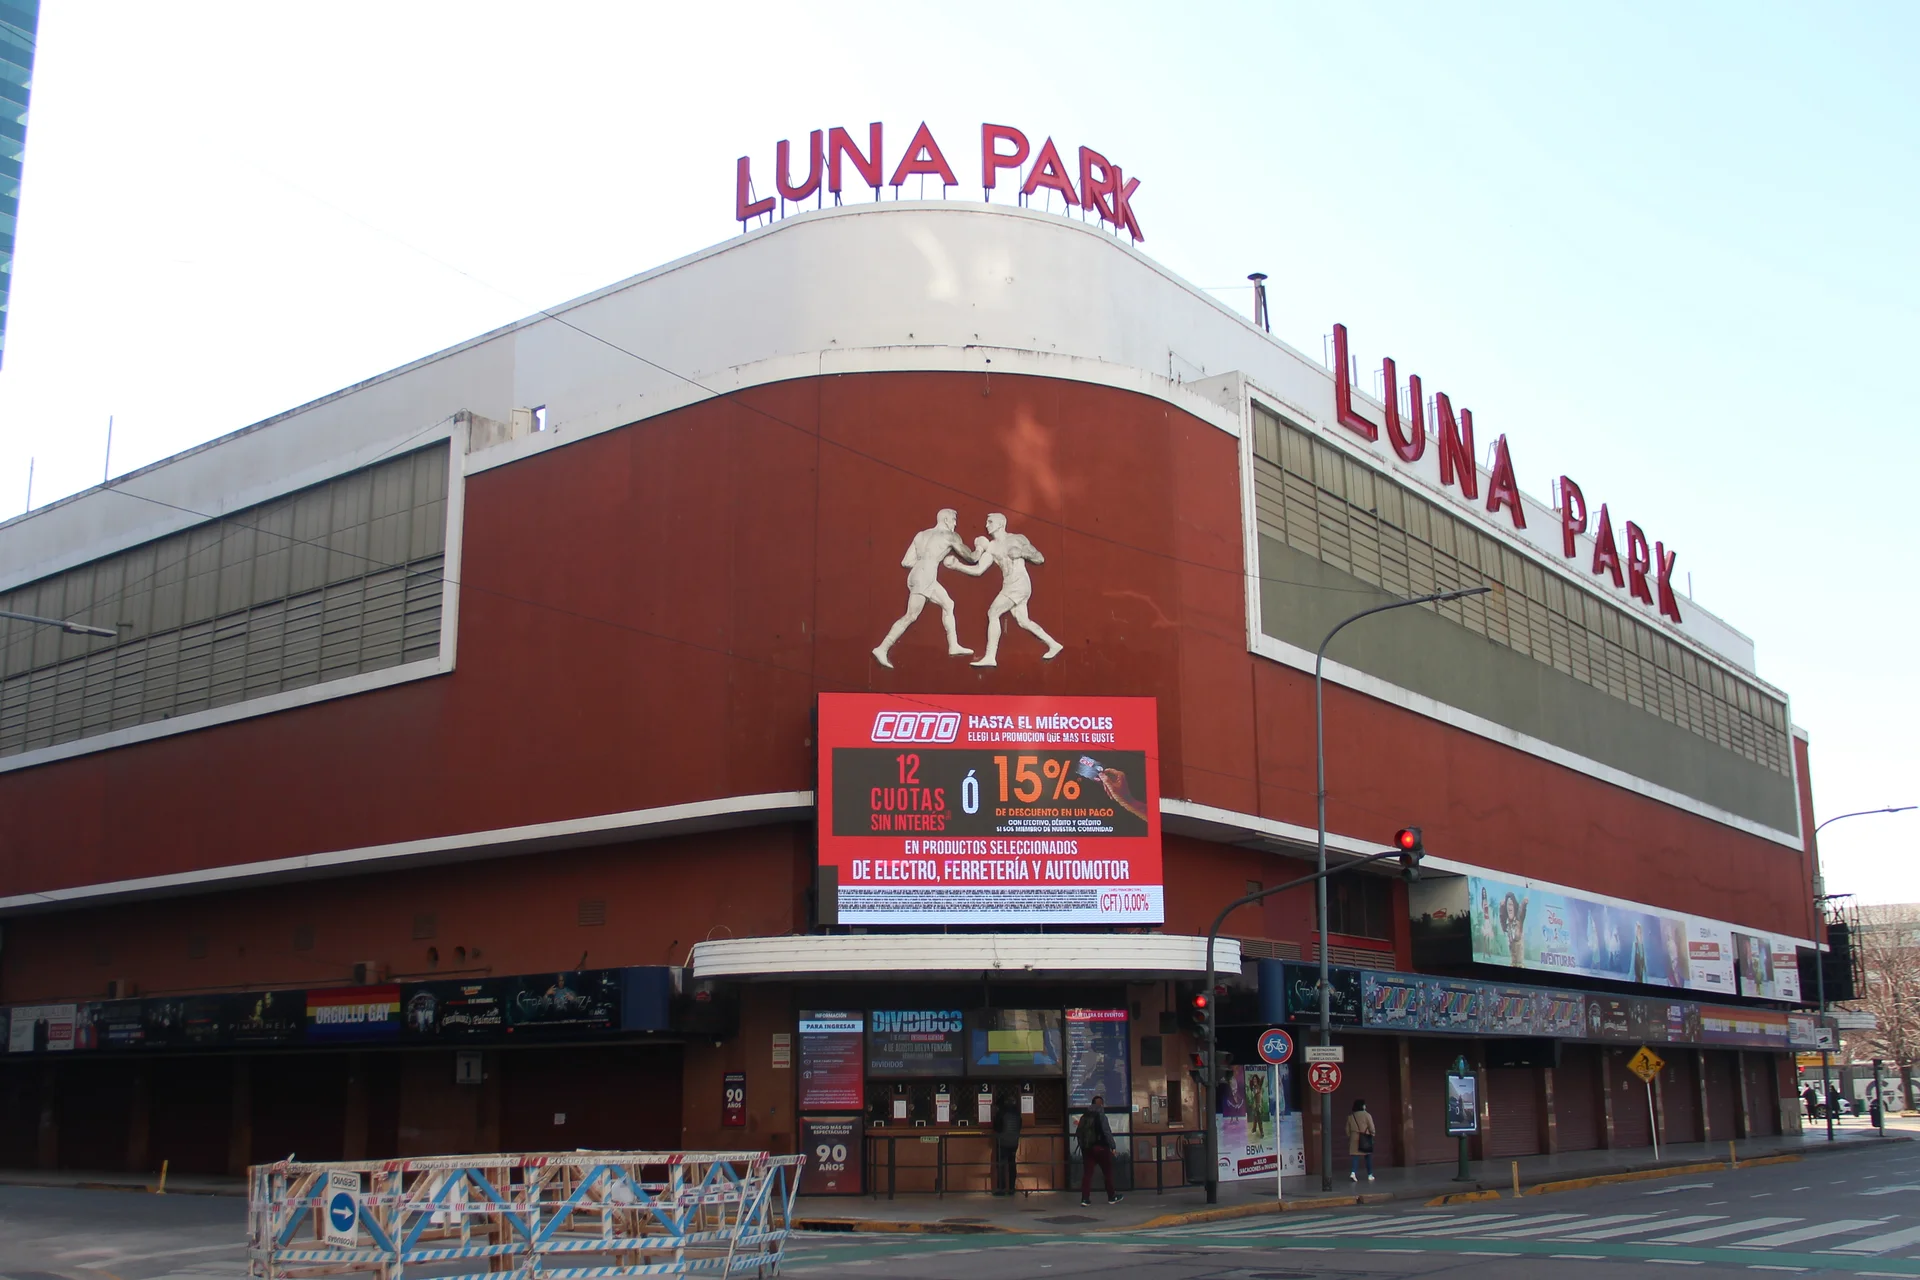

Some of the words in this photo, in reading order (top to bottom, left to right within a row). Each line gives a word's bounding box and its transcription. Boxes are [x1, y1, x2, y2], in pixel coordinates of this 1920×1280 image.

[736, 121, 958, 221] LUNA
[982, 122, 1144, 242] PARK
[1333, 323, 1527, 529] LUNA
[1560, 475, 1682, 623] PARK
[873, 713, 961, 741] COTO
[968, 715, 1014, 729] HASTA
[1018, 716, 1032, 729] EL
[1035, 712, 1113, 730] MIÉRCOLES
[968, 732, 989, 742] ELEGI
[990, 732, 1000, 742] LA
[1002, 732, 1044, 742] PROMOCION
[1047, 733, 1061, 743] QUE
[1063, 733, 1079, 743] MAS
[1081, 733, 1090, 743] TE
[1091, 733, 1115, 743] GUSTE
[896, 753, 920, 785] 12
[993, 755, 1081, 804] 15%
[871, 787, 945, 812] CUOTAS
[995, 808, 1007, 817] DE
[1008, 808, 1059, 817] DESCUENTO
[1061, 808, 1072, 817] EN
[1074, 808, 1086, 817] UN
[1088, 808, 1114, 817] PAGO
[871, 813, 891, 831] SIN
[895, 811, 945, 831] INTERÉS
[905, 840, 919, 854] EN
[922, 840, 987, 855] PRODUCTOS
[990, 840, 1078, 855] SELECCIONADOS
[852, 860, 871, 880] DE
[875, 860, 941, 882] ELECTRO,
[944, 856, 1029, 880] FERRETERÍA
[1031, 860, 1042, 880] Y
[1045, 860, 1129, 880] AUTOMOTOR
[1540, 952, 1576, 968] AVENTURAS
[315, 1004, 365, 1024] ORGULLO
[367, 1003, 392, 1022] GAY
[872, 1010, 963, 1033] DIVIDIDOS
[229, 1022, 297, 1030] PIMPINELA
[465, 1061, 470, 1077] 1
[871, 1060, 903, 1068] DIVIDIDOS
[726, 1088, 743, 1102] 90
[898, 1084, 903, 1092] 1
[939, 1084, 946, 1093] 2
[981, 1083, 989, 1093] 3
[1023, 1083, 1030, 1092] 4
[816, 1144, 847, 1162] 90
[1246, 1144, 1264, 1155] BBVA
[818, 1162, 845, 1171] AÑOS
